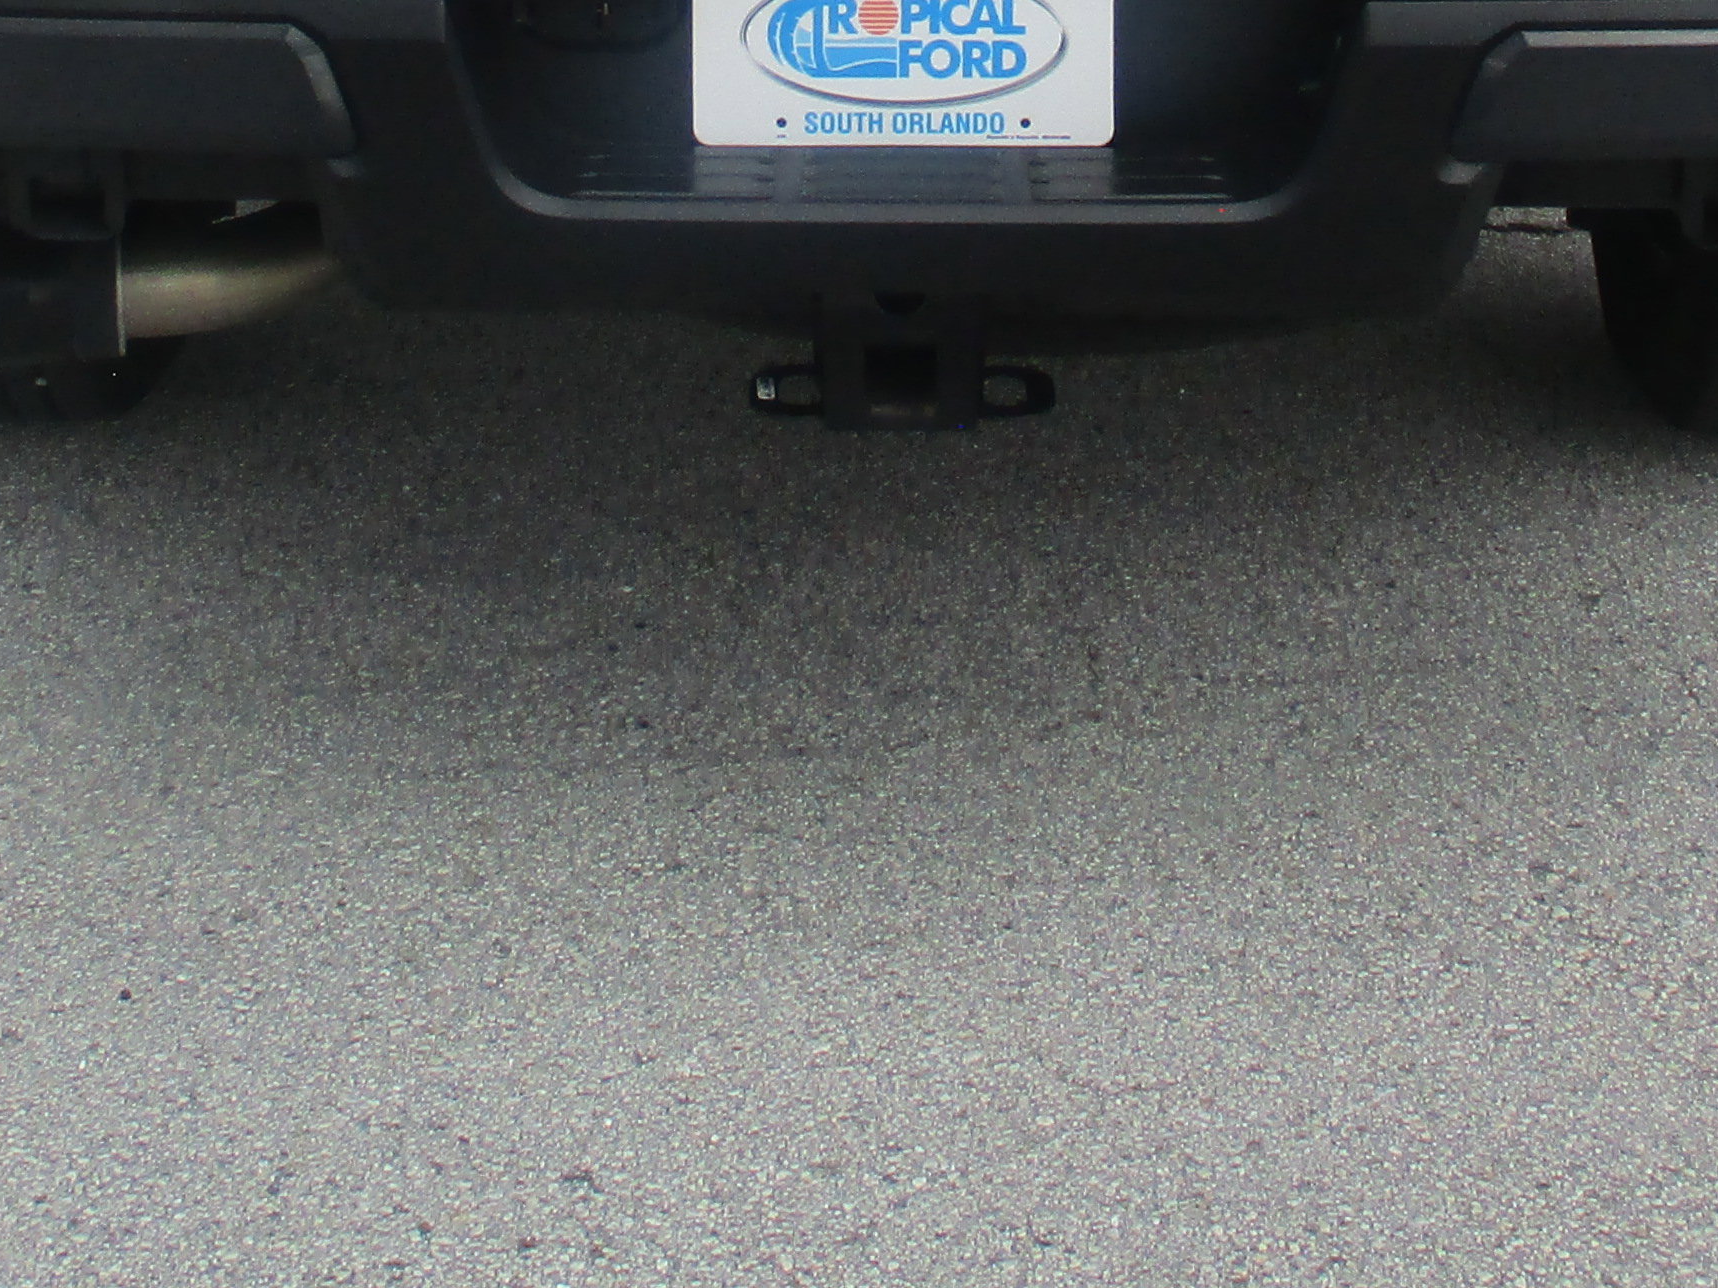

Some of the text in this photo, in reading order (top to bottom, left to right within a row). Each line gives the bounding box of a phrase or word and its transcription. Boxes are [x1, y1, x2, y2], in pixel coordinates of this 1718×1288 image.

[898, 40, 1027, 79] FORD
[804, 112, 1006, 135] SOUTH ORLANDO
